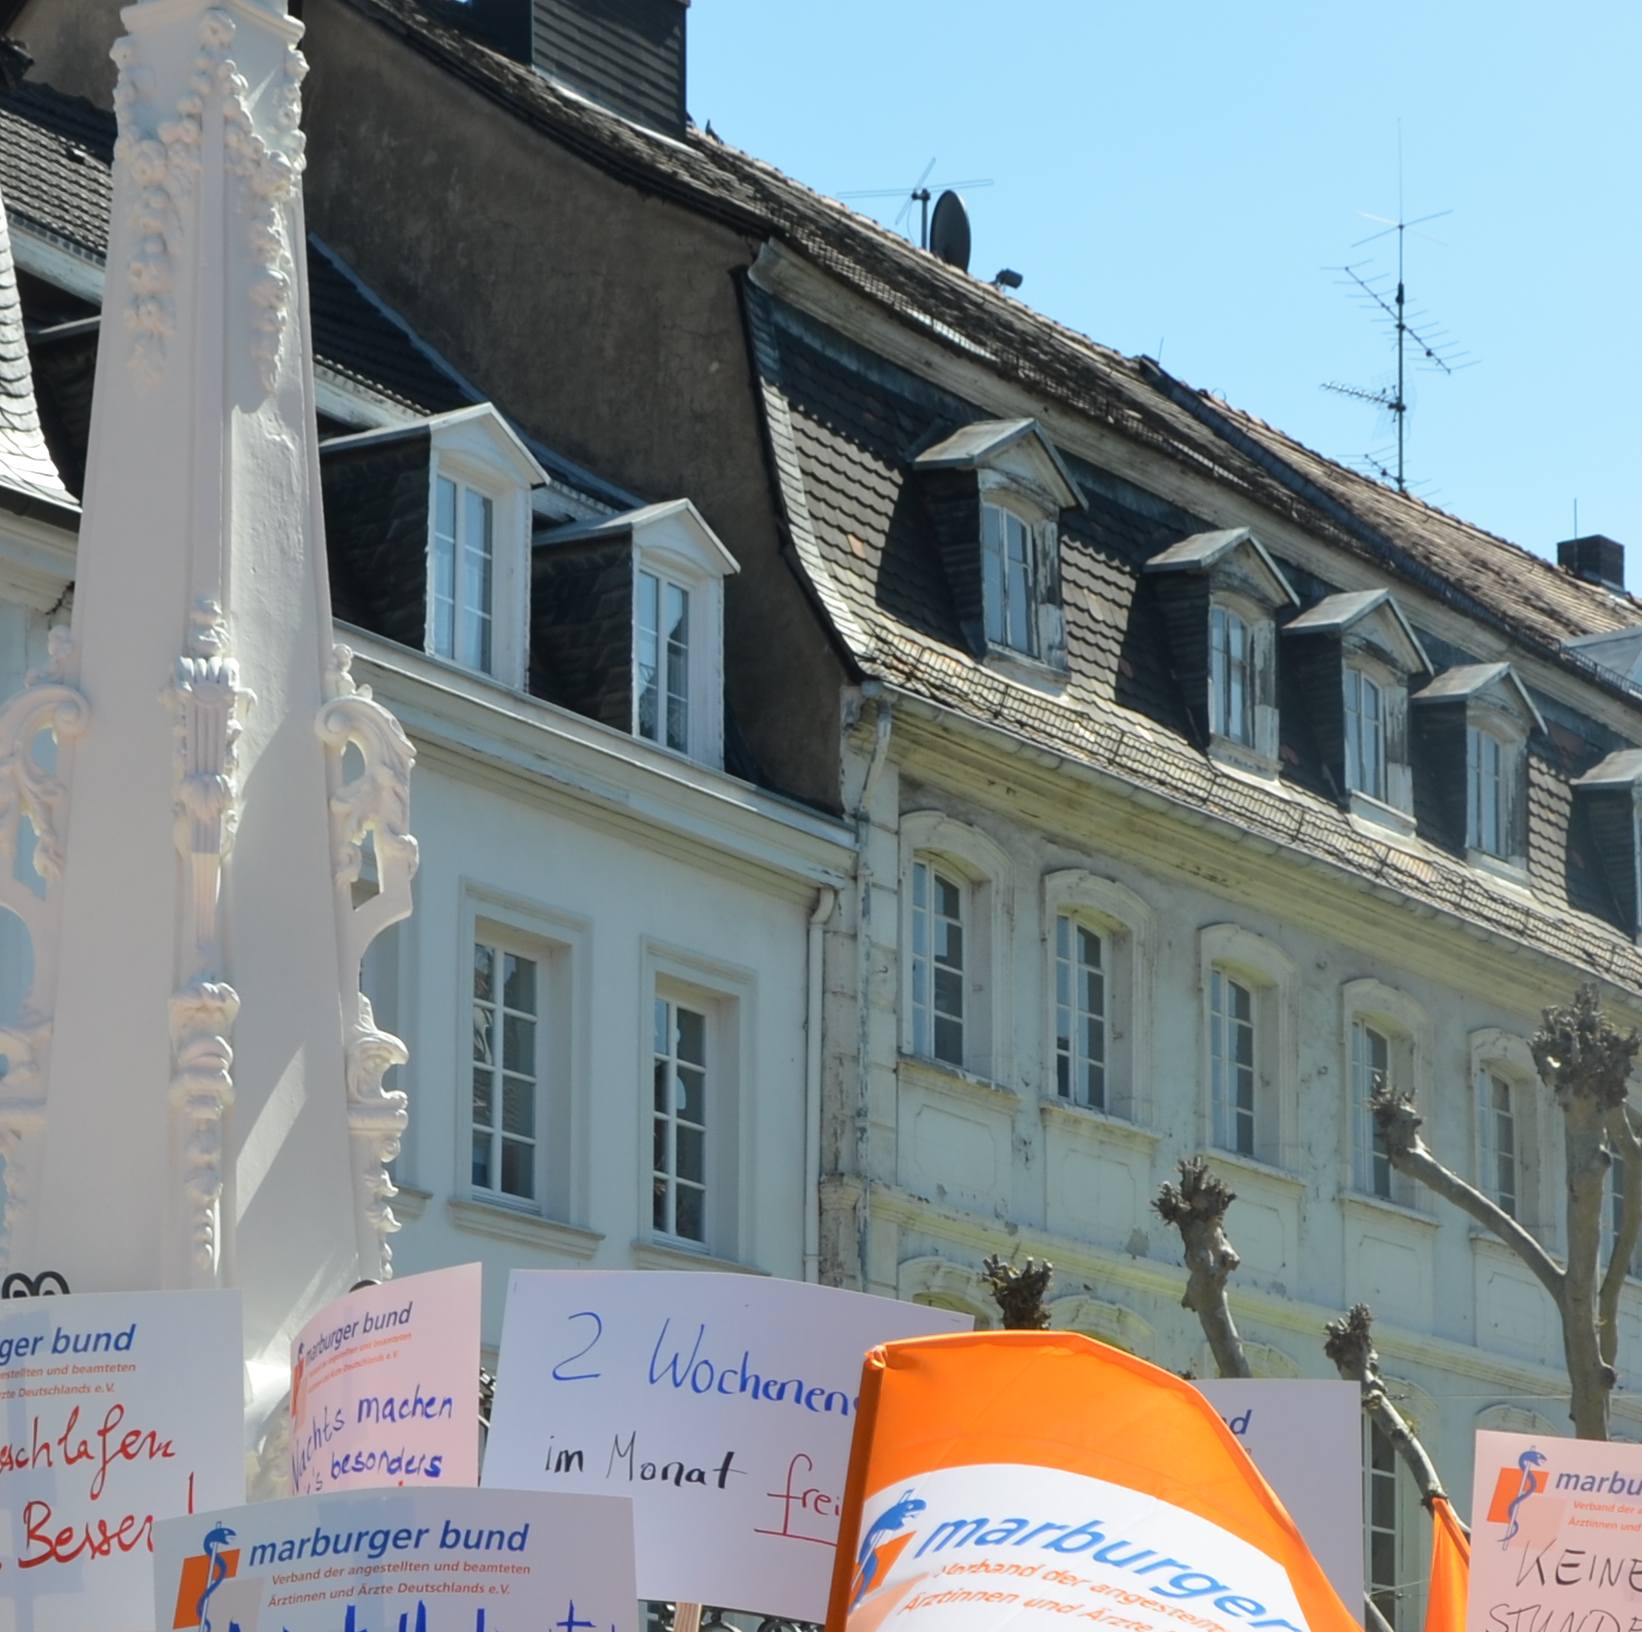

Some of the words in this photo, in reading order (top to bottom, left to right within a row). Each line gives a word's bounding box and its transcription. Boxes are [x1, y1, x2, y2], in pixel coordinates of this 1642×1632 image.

[362, 1301, 413, 1334] bund
[51, 1323, 137, 1355] bund
[47, 1364, 69, 1375] und
[72, 1361, 136, 1374] beamteten
[552, 1311, 603, 1381] 2
[648, 1317, 859, 1417] Wochenen
[19, 1383, 91, 1398] Deutschlands
[95, 1382, 115, 1394] e.V.
[357, 1383, 453, 1424] machen
[330, 1447, 443, 1480] besonders
[544, 1435, 584, 1473] im
[606, 1431, 748, 1490] Monat
[766, 1453, 841, 1537] frei
[1568, 1516, 1618, 1530] Ärztinnen
[1620, 1522, 1642, 1532] und
[1573, 1501, 1615, 1513] Verband
[1617, 1504, 1636, 1515] der
[249, 1525, 429, 1567] marburger
[438, 1520, 530, 1553] bund
[272, 1568, 322, 1586] Verband
[325, 1564, 345, 1578] der
[348, 1560, 431, 1577] angestellten
[434, 1559, 460, 1573] und
[463, 1560, 531, 1576] beamteten
[1042, 1568, 1092, 1588] der
[267, 1589, 326, 1608] Ärztinnen
[329, 1585, 354, 1599] und
[358, 1580, 394, 1597] Ärzte
[397, 1580, 485, 1596] Deutschlands
[489, 1583, 511, 1596] e.V.
[897, 1588, 1020, 1616] Ärztinnen
[1024, 1597, 1085, 1614] und
[1079, 1607, 1154, 1632] Ärzte
